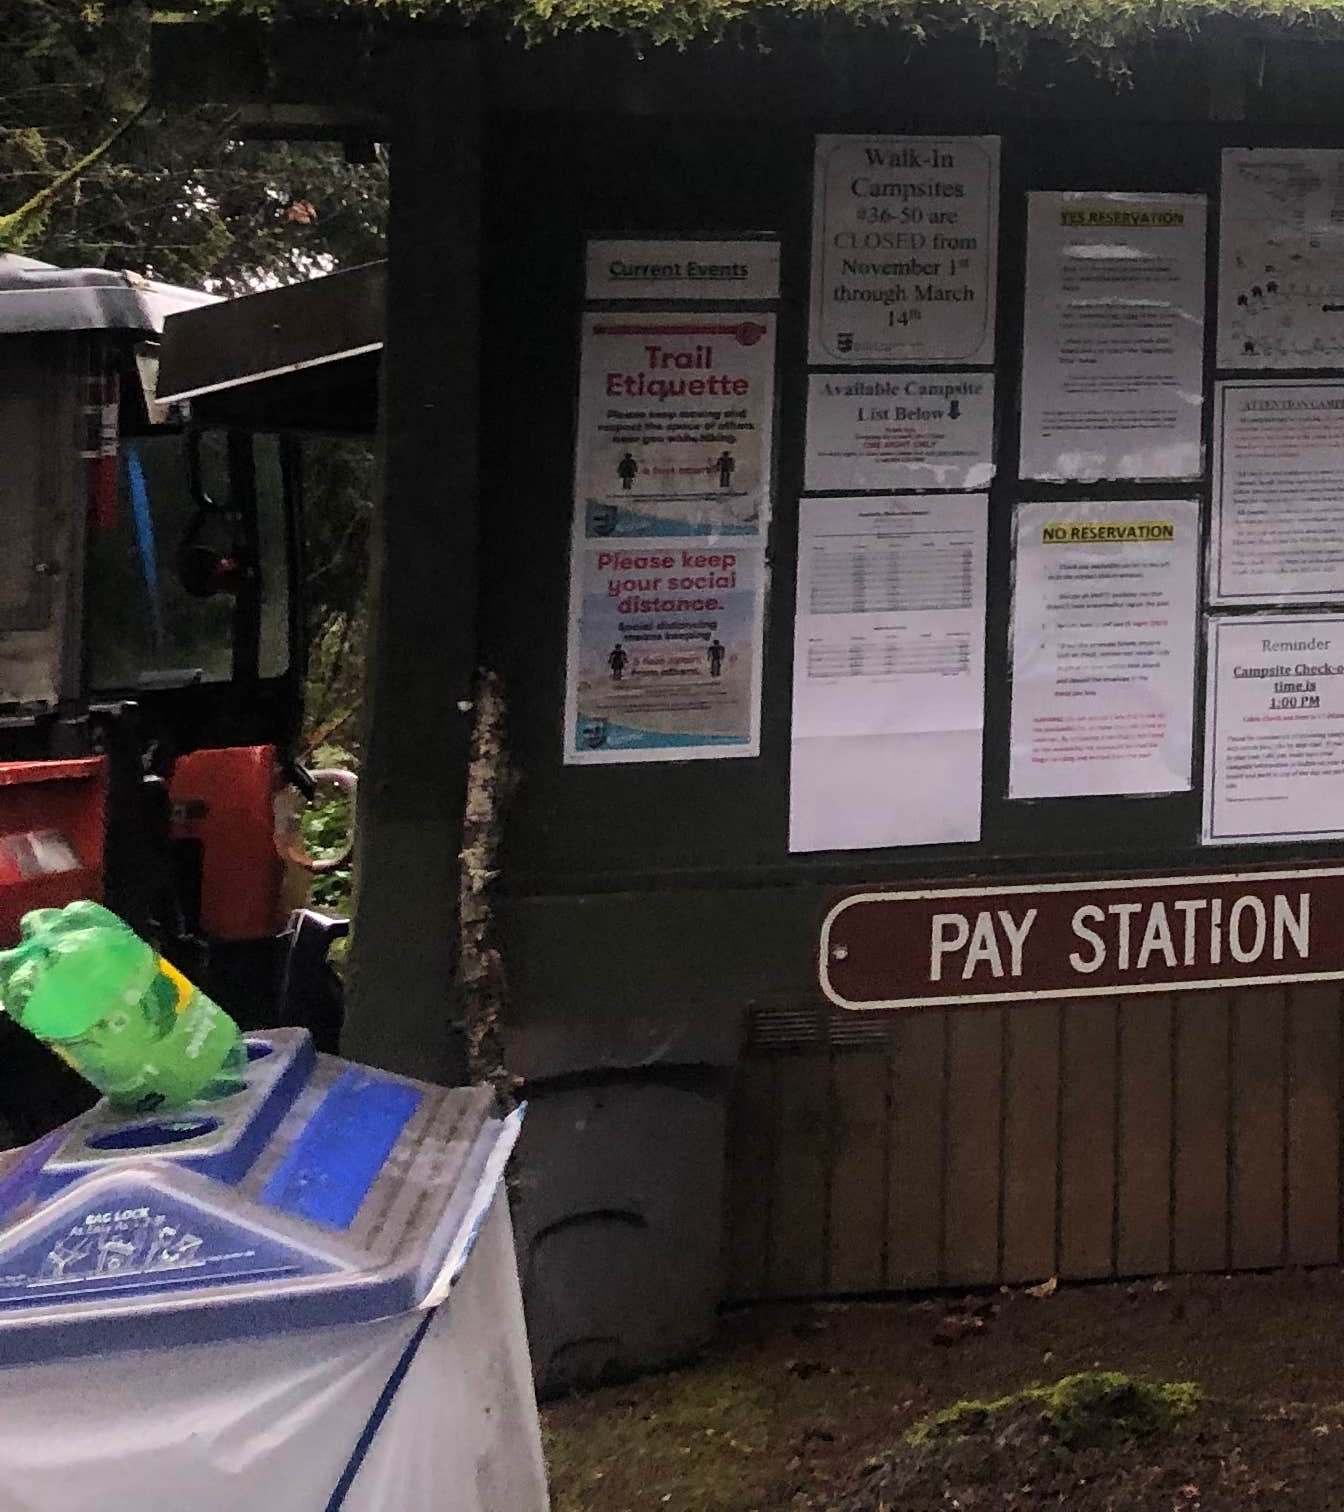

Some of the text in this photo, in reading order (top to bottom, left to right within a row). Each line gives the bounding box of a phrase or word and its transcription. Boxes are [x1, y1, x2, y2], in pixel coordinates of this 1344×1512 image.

[865, 148, 954, 167] Walk-In
[851, 178, 965, 201] Campsites
[928, 211, 958, 224] are
[834, 232, 977, 249] CLOSED from
[609, 261, 749, 278] Current Events
[841, 258, 941, 276] November
[833, 284, 974, 306] through March
[645, 346, 713, 369] Trail
[606, 373, 750, 401] Etiquette
[820, 381, 983, 399] Available Campsite
[858, 407, 945, 422] List Below
[1043, 525, 1173, 541] NO RESERVATION
[598, 551, 736, 571] Please keep
[608, 572, 736, 597] your social
[618, 596, 724, 614] distance.
[1261, 637, 1331, 653] Reminder
[1233, 665, 1291, 680] Campsite
[1274, 679, 1316, 693] time is
[1270, 695, 1320, 709] 1:00 PM
[930, 893, 1310, 982] PAY STATION
